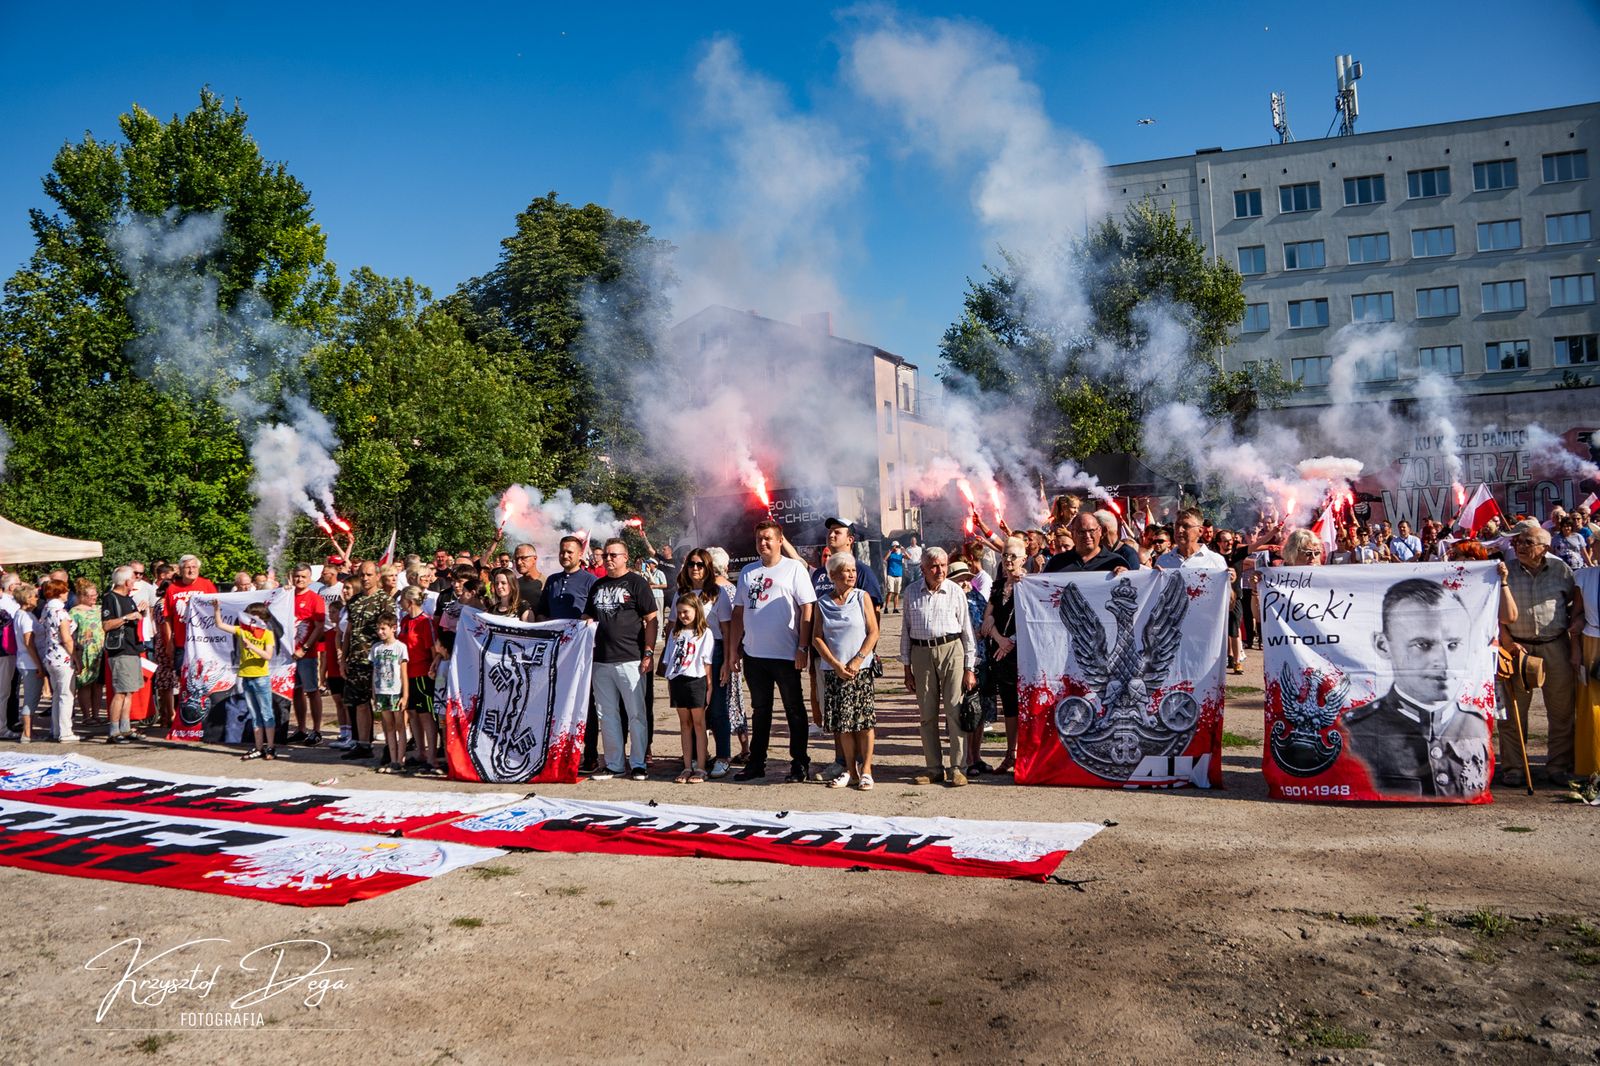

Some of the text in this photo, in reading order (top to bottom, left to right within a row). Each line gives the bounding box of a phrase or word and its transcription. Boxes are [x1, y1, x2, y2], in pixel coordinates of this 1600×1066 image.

[1263, 572, 1313, 589] Witold
[1263, 589, 1354, 623] Pilecki
[1267, 634, 1340, 647] WITOLD
[1123, 753, 1212, 789] AK
[1280, 784, 1350, 797] 1901-1948
